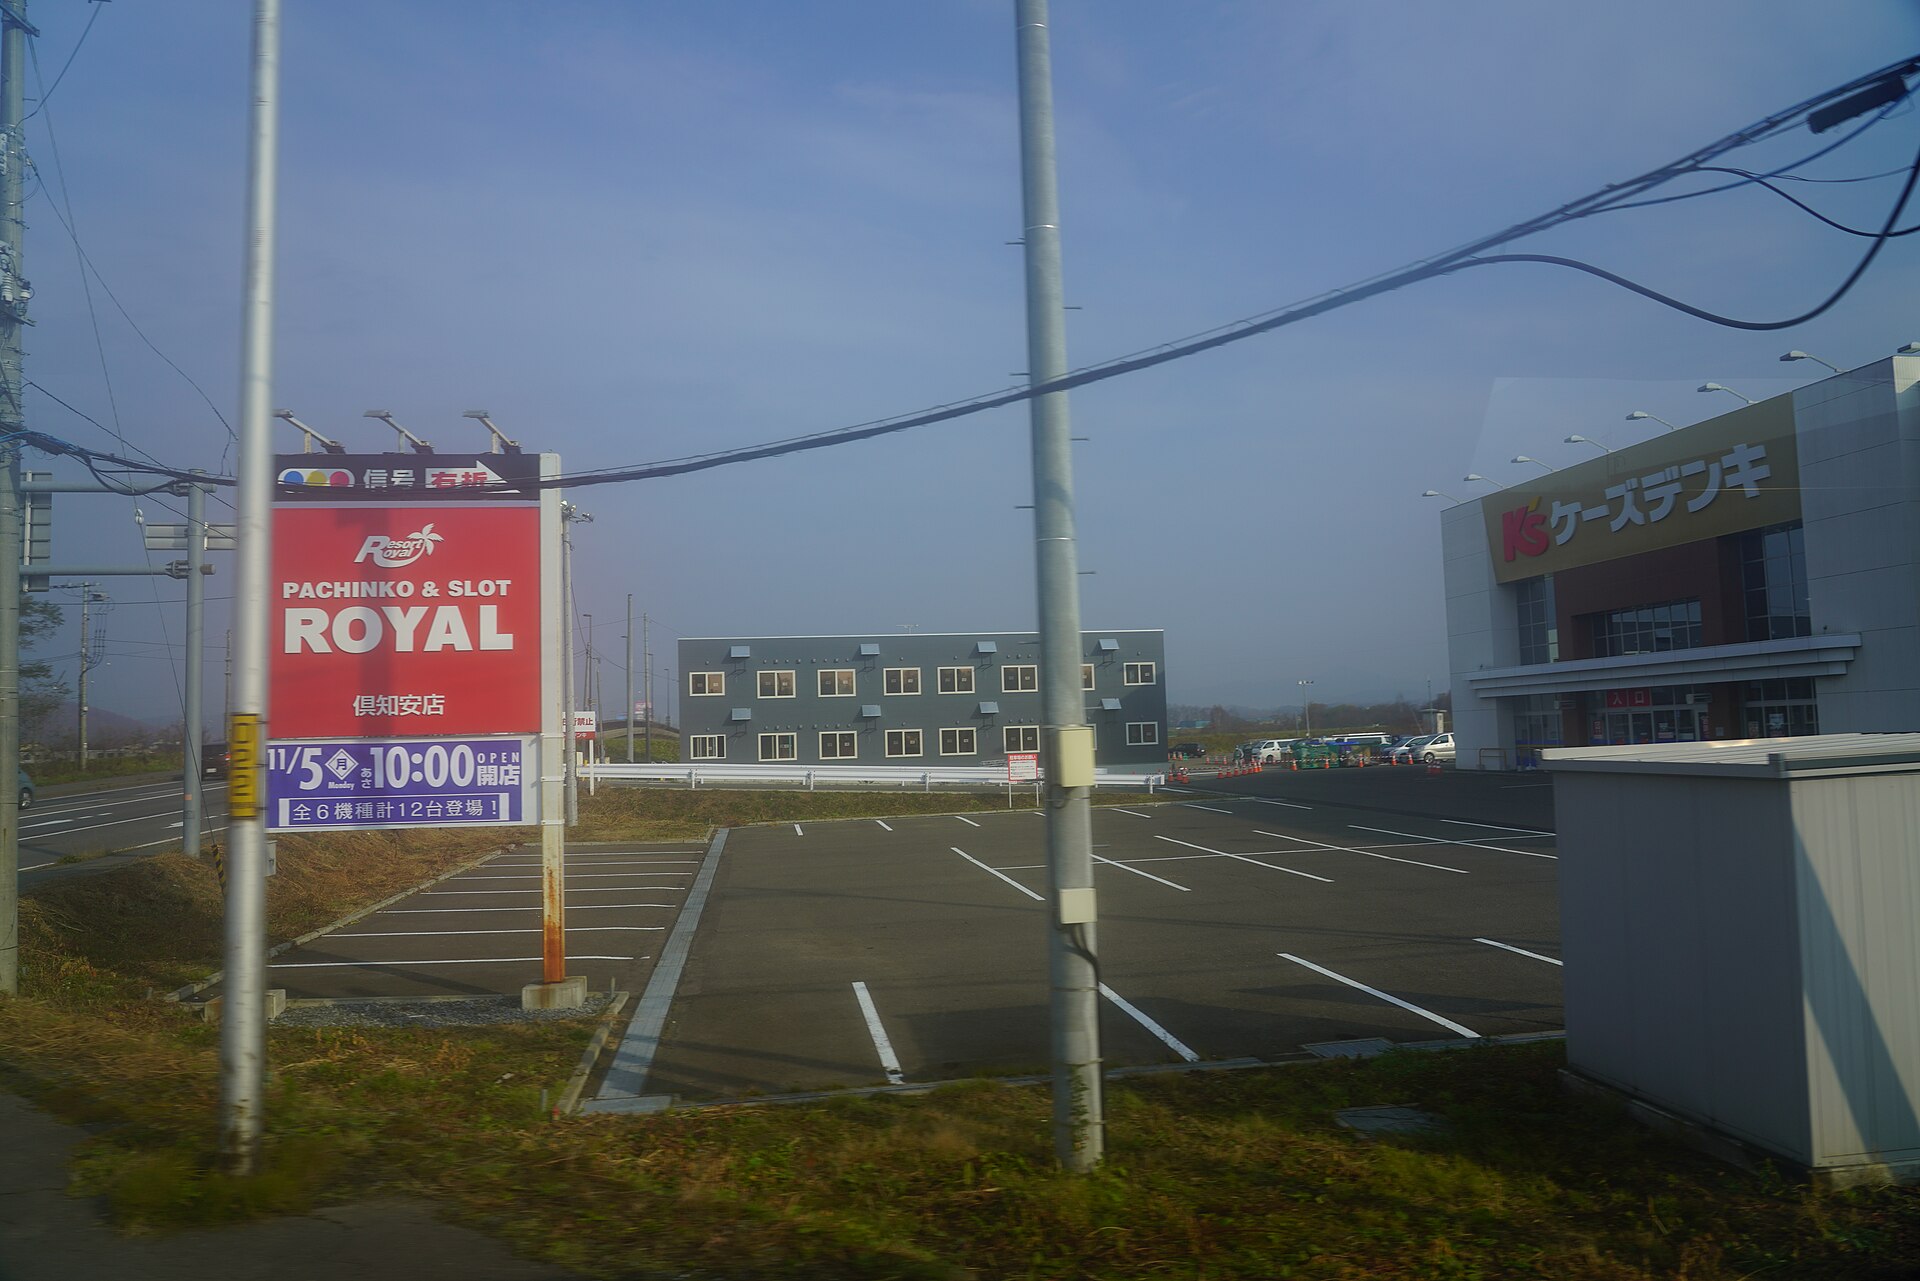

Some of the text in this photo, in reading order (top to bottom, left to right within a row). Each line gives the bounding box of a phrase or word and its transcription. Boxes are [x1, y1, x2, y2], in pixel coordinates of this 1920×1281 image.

[363, 468, 415, 491] 信号
[1550, 443, 1771, 546] ケーズデンキ
[283, 579, 511, 599] PACHINKO & SLOT
[284, 604, 514, 654] ROYAL
[352, 693, 445, 716] 倶知安店
[1612, 691, 1644, 705] 入口
[267, 746, 323, 790] 11/5
[335, 757, 348, 771] 月
[370, 744, 475, 789] 10:00
[477, 752, 520, 764] OPEN
[327, 781, 355, 791] Monday
[360, 767, 373, 789] あさ
[476, 764, 521, 787] 開店
